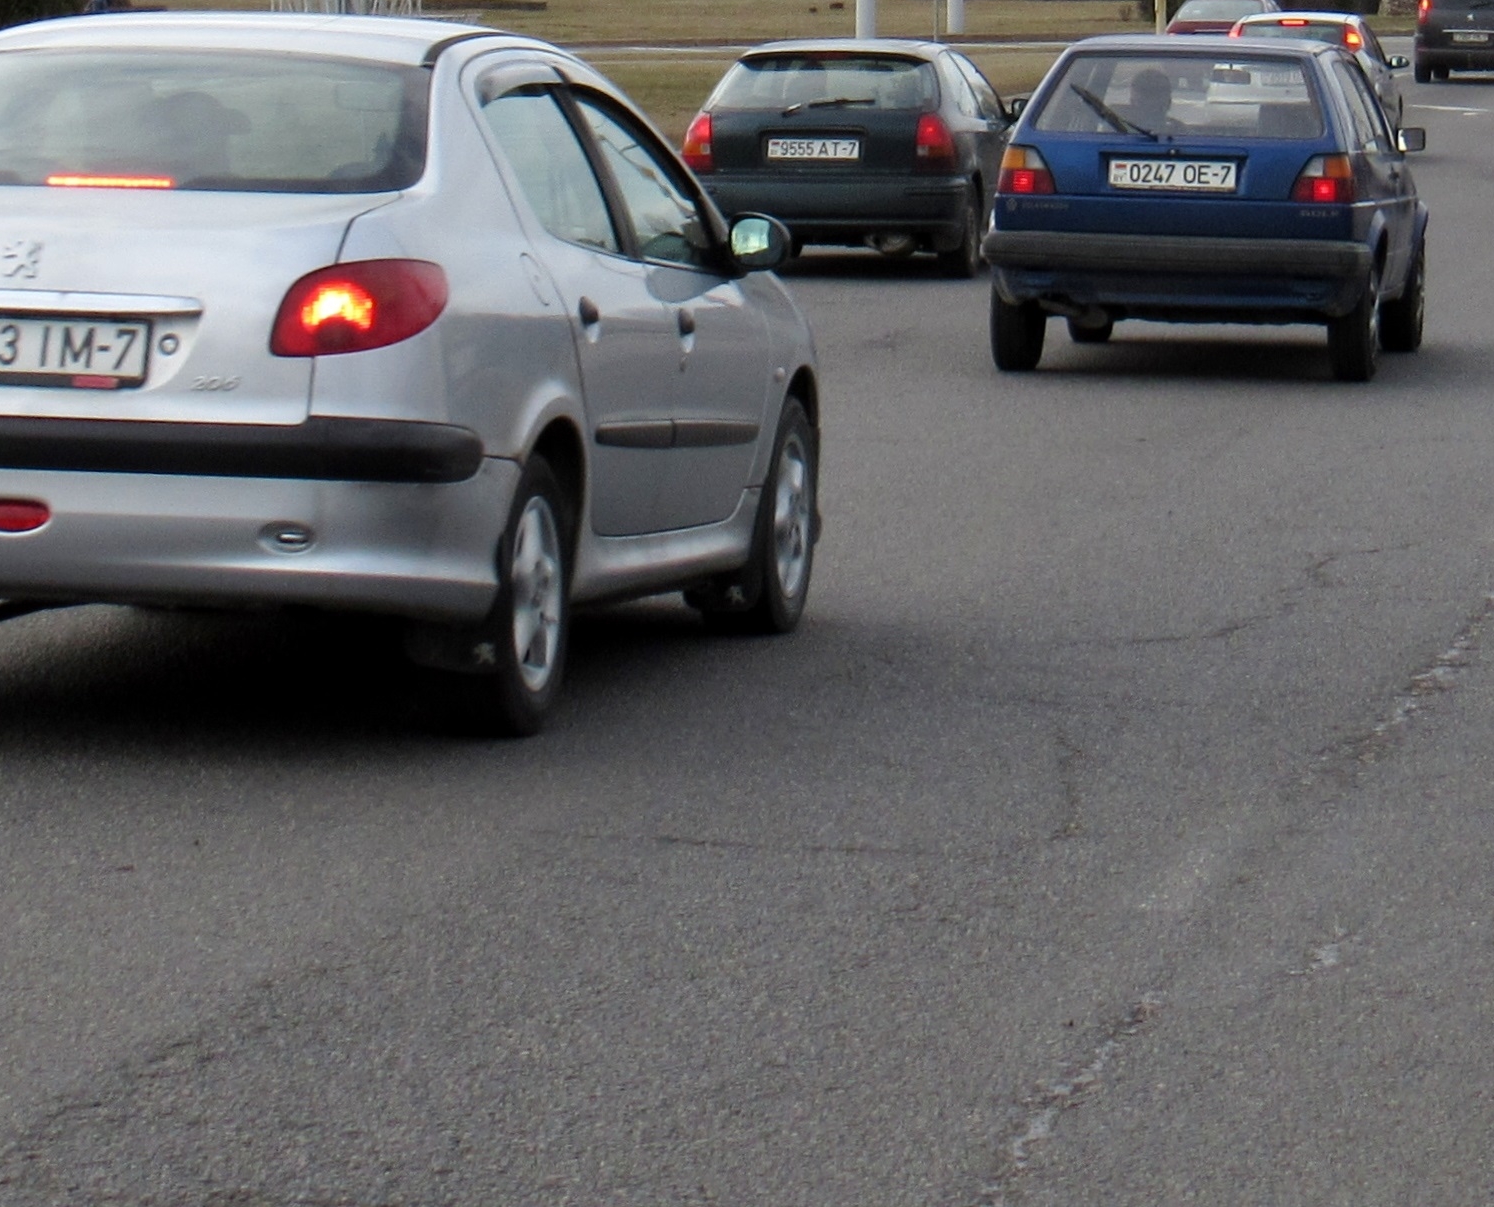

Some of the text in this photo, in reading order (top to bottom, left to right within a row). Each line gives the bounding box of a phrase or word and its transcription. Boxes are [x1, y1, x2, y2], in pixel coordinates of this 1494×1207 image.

[780, 141, 815, 156] 9555
[1128, 164, 1232, 185] 0247 OE-7
[37, 324, 141, 372] IM-7
